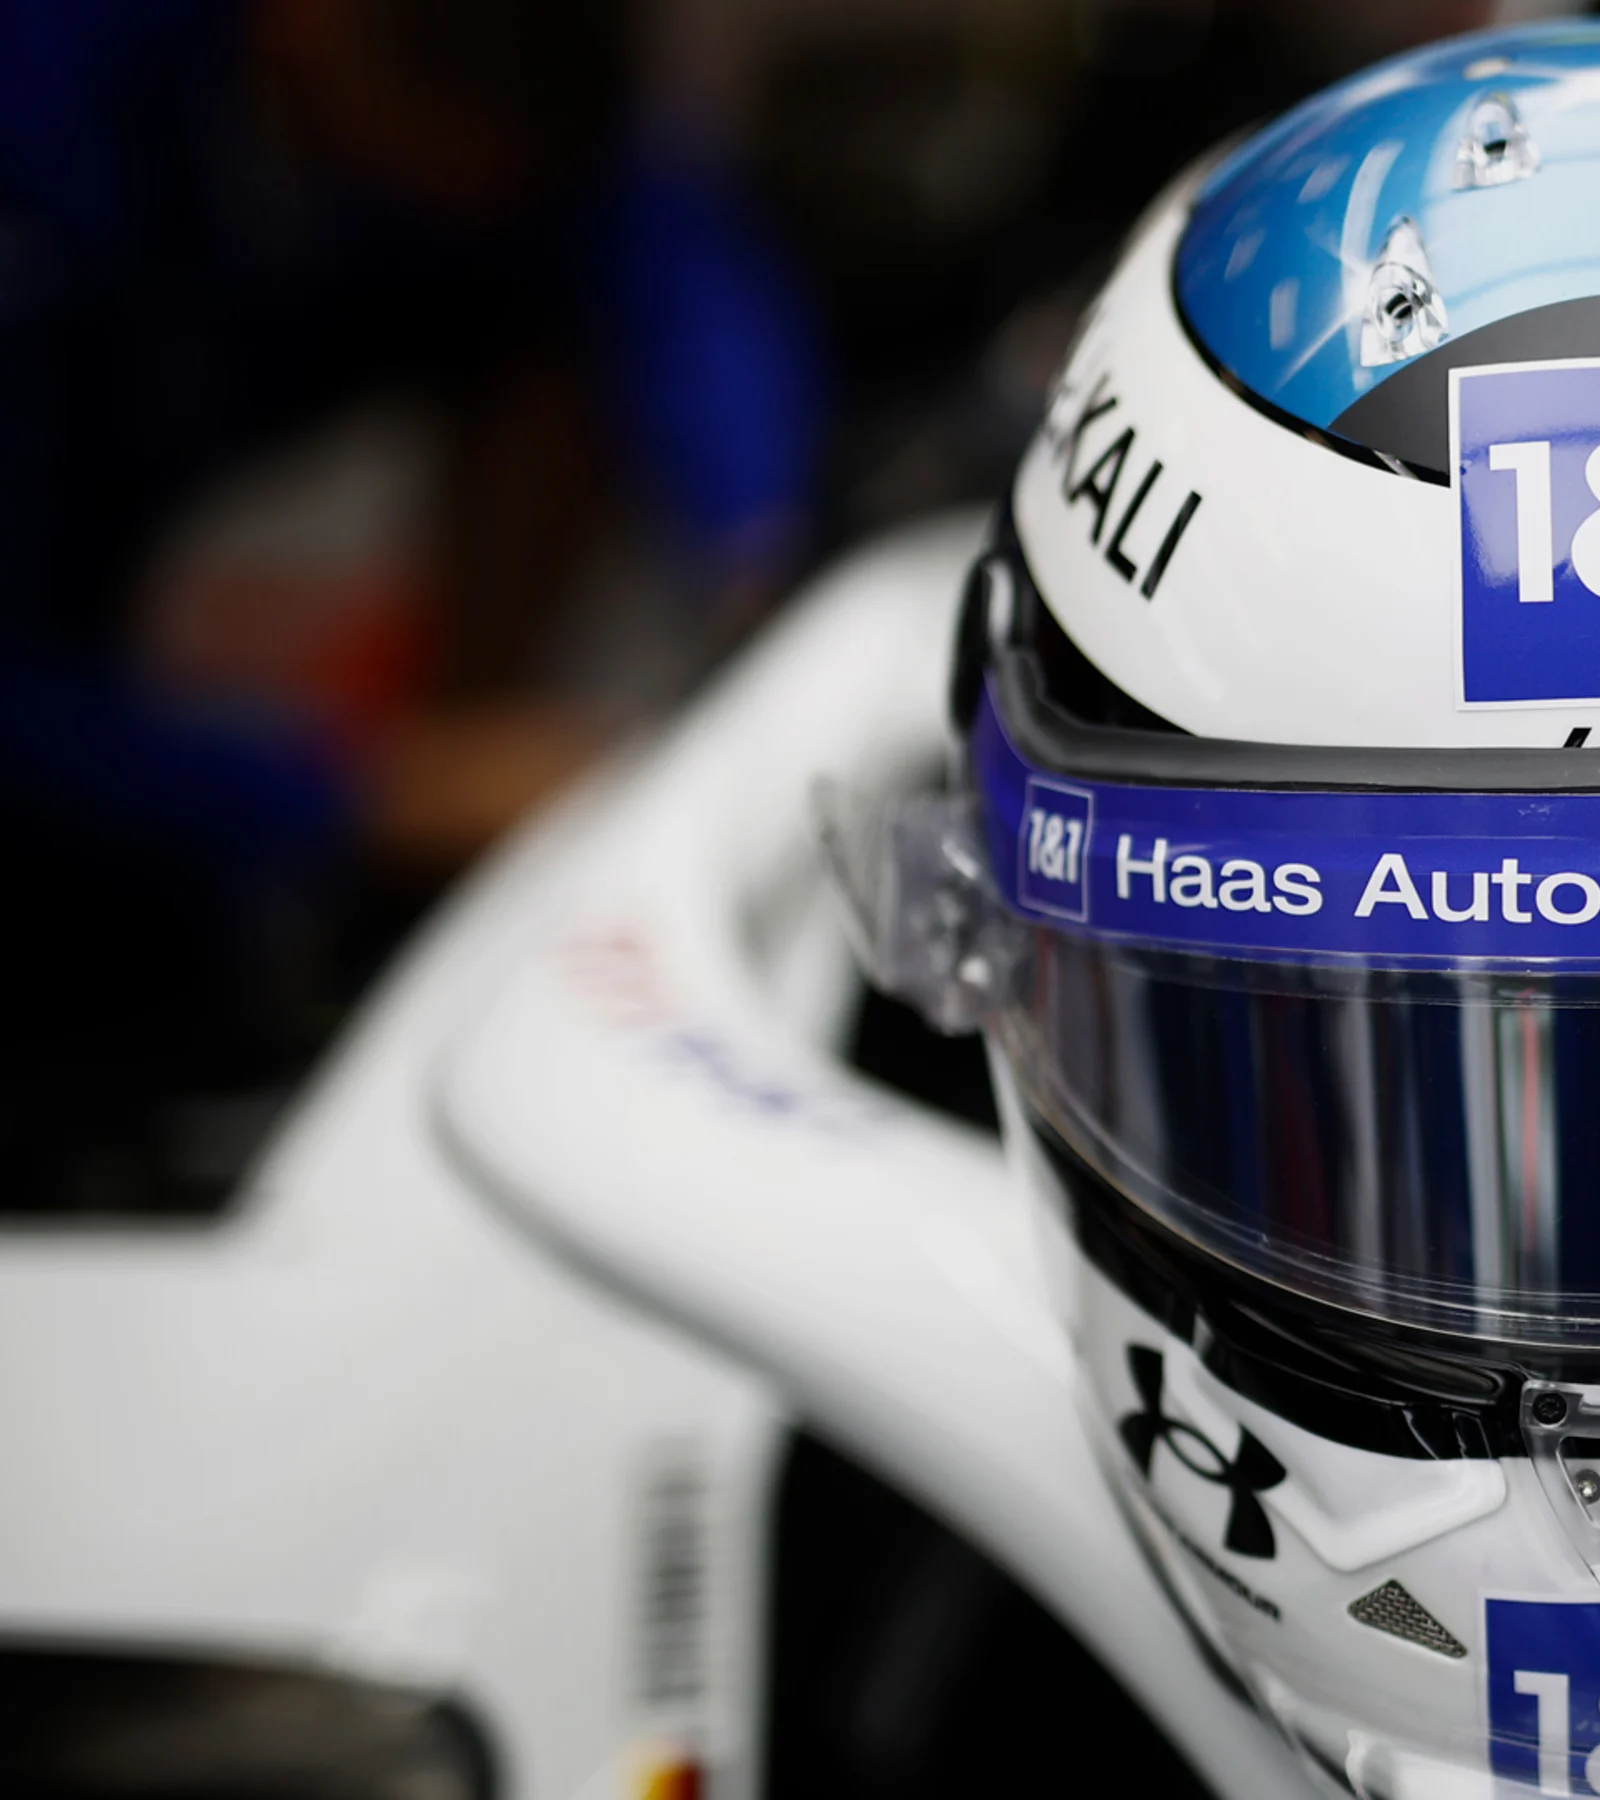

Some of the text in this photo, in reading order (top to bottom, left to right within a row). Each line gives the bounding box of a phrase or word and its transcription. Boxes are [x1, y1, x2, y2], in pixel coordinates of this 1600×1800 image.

[1049, 370, 1203, 602] KALI
[1028, 808, 1084, 885] 1&1
[1116, 833, 1324, 916] Haas
